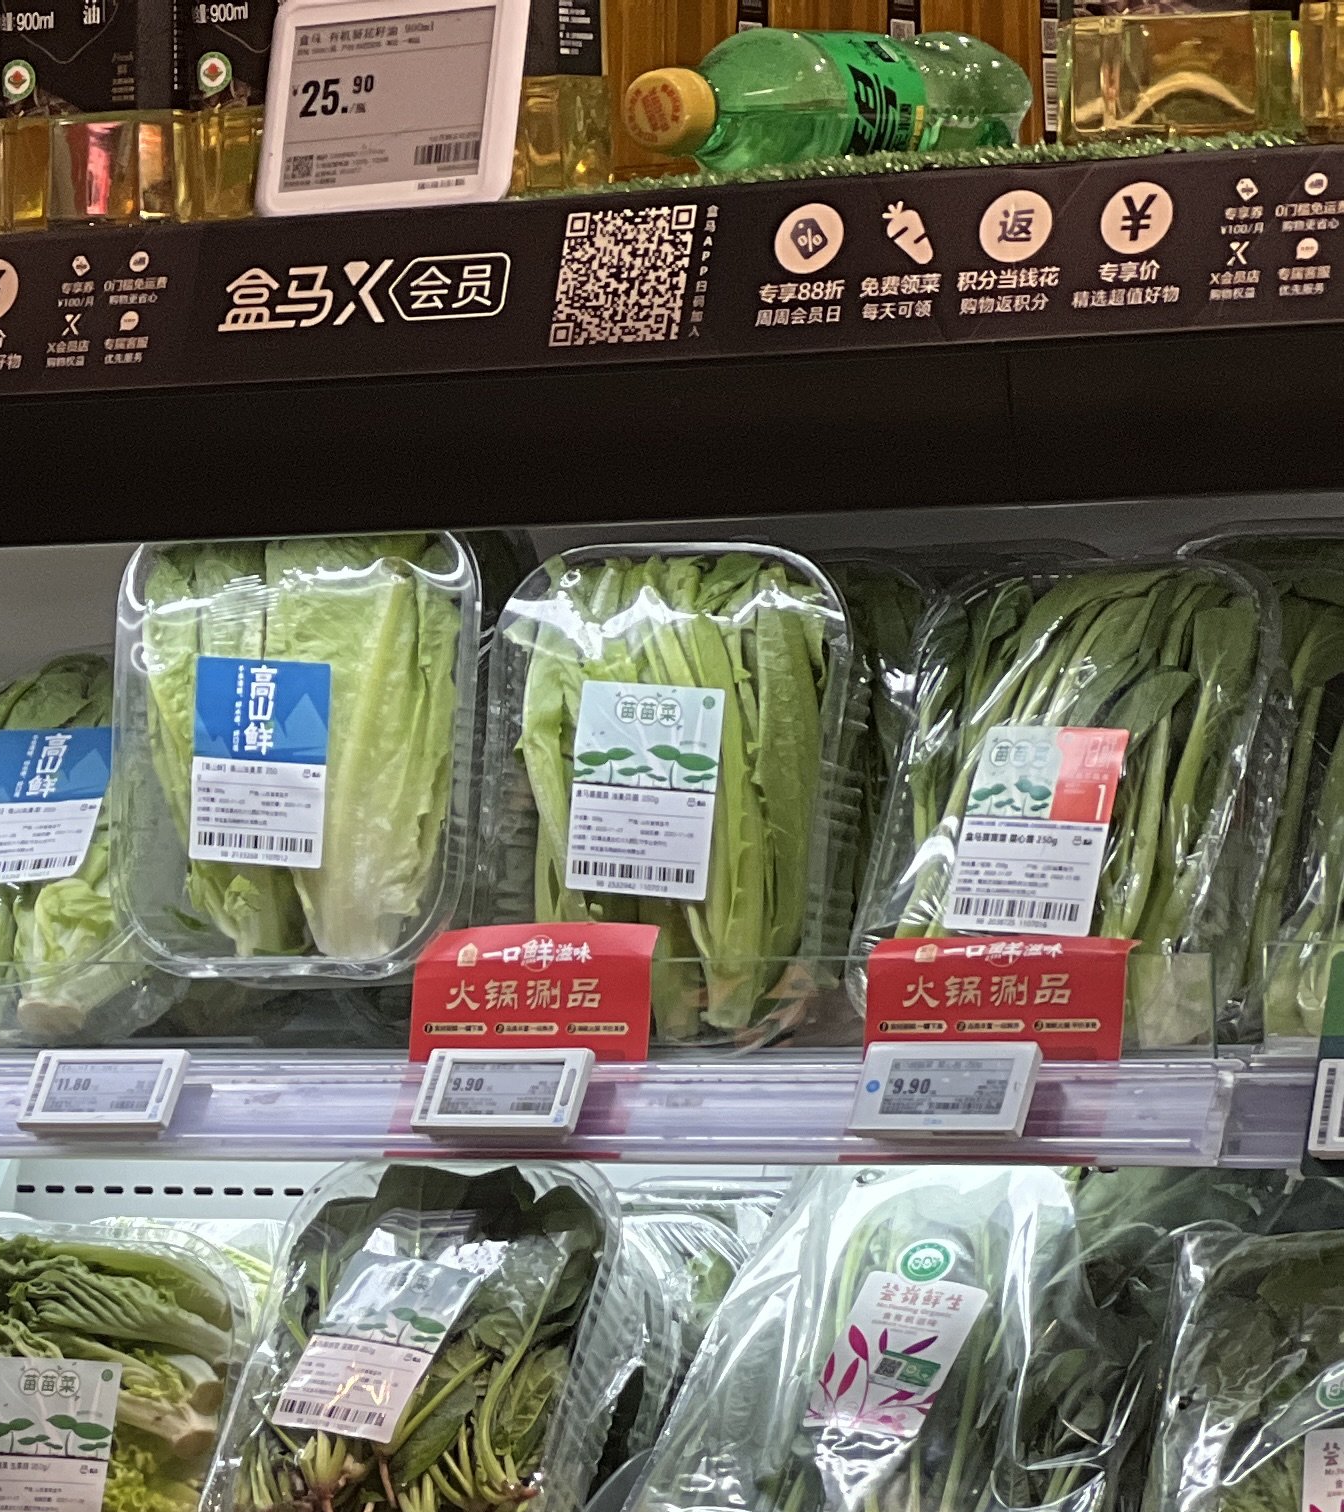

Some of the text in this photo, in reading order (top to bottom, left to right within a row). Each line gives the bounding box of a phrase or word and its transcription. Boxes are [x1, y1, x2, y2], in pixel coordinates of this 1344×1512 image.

[957, 266, 1060, 292] 积分当钱花
[1098, 259, 1160, 283] 专享价
[758, 279, 846, 303] 专享88折
[859, 273, 942, 298] 免费领菜
[1071, 285, 1180, 309] 精选超值好物
[755, 305, 841, 327] 周周会员日
[861, 299, 933, 321] 每天可领
[959, 292, 1050, 316] 购物返积分
[243, 664, 278, 756] 高山鲜
[620, 700, 677, 722] 苗苗菜
[28, 733, 73, 798] 高山鲜
[445, 978, 602, 1011] 火锅涮品
[902, 972, 1073, 1008] 火锅涮品
[22, 1372, 75, 1394] 苗苗菜
